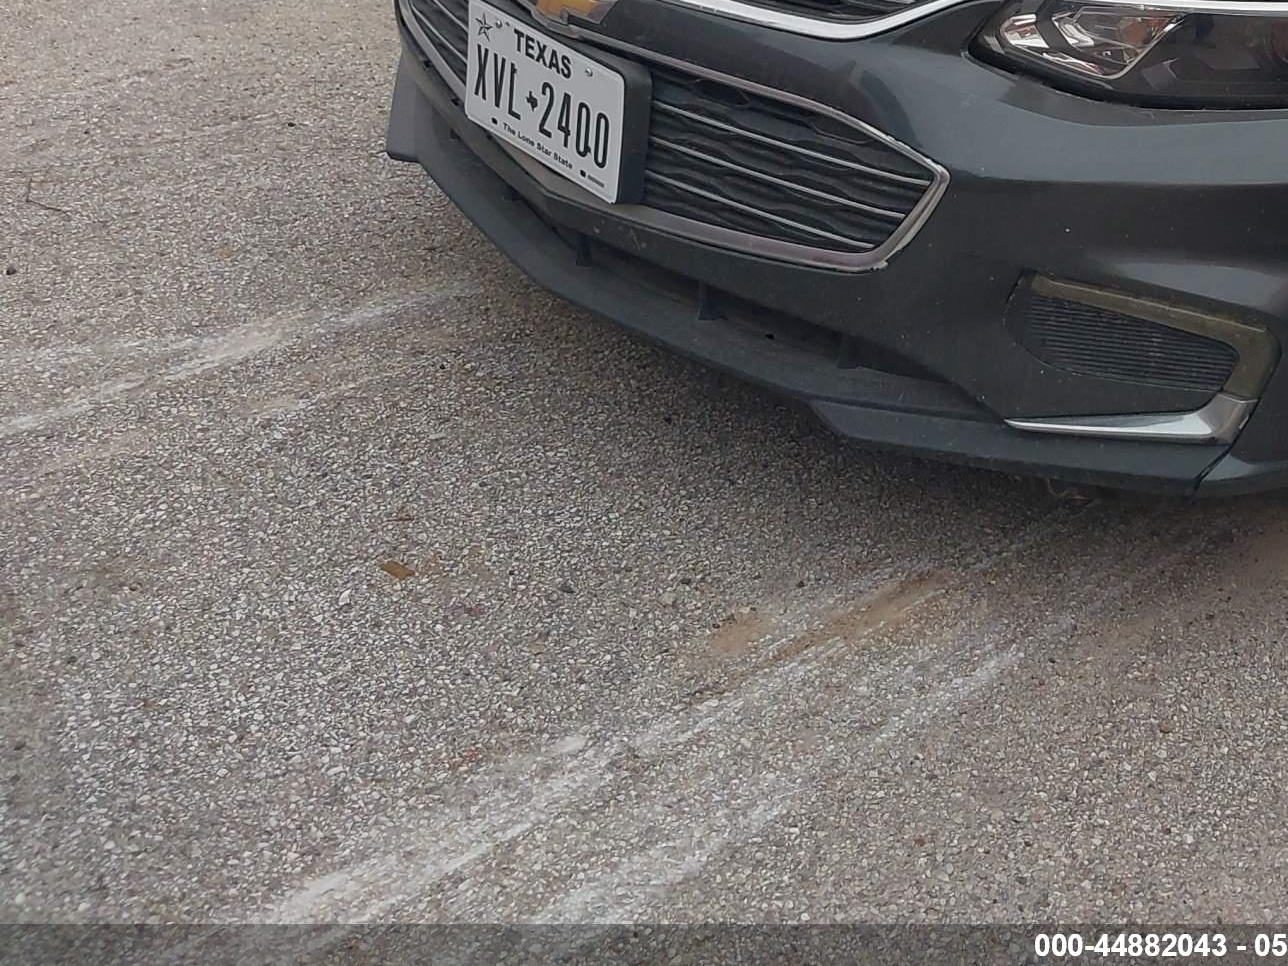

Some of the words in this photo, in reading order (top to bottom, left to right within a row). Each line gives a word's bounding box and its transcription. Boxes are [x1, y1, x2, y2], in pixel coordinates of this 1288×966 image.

[513, 28, 572, 80] TEXAS
[474, 43, 521, 121] XVL
[538, 81, 610, 169] 2400
[502, 121, 516, 137] The
[518, 130, 534, 147] Lone
[536, 141, 552, 157] Star
[553, 152, 573, 170] State
